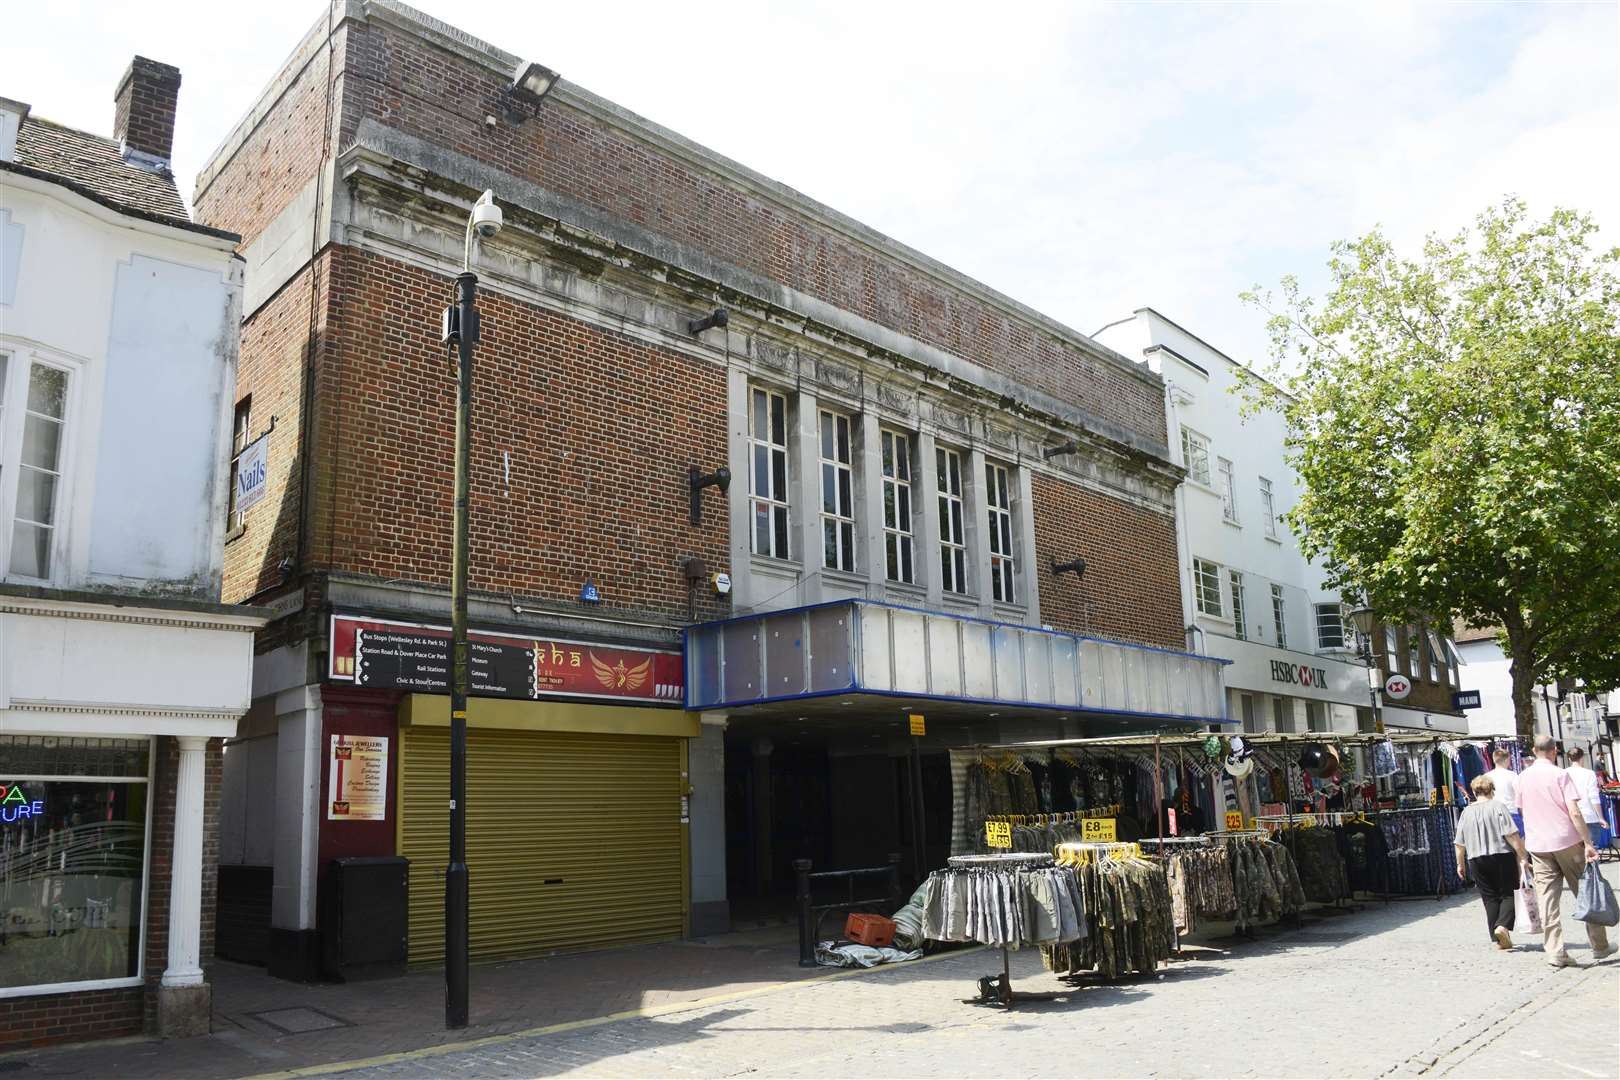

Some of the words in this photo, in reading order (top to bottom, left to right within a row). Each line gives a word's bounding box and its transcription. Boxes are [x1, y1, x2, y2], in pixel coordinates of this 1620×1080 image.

[238, 460, 265, 497] Nails
[374, 634, 387, 642] Stops
[362, 646, 380, 654] Station
[1270, 660, 1299, 684] HSBC
[1312, 667, 1328, 689] UK
[485, 684, 506, 692] Information
[1458, 695, 1478, 706] MANN
[988, 822, 1008, 833] £7.99
[1086, 821, 1100, 832] £8
[1226, 815, 1241, 829] £25
